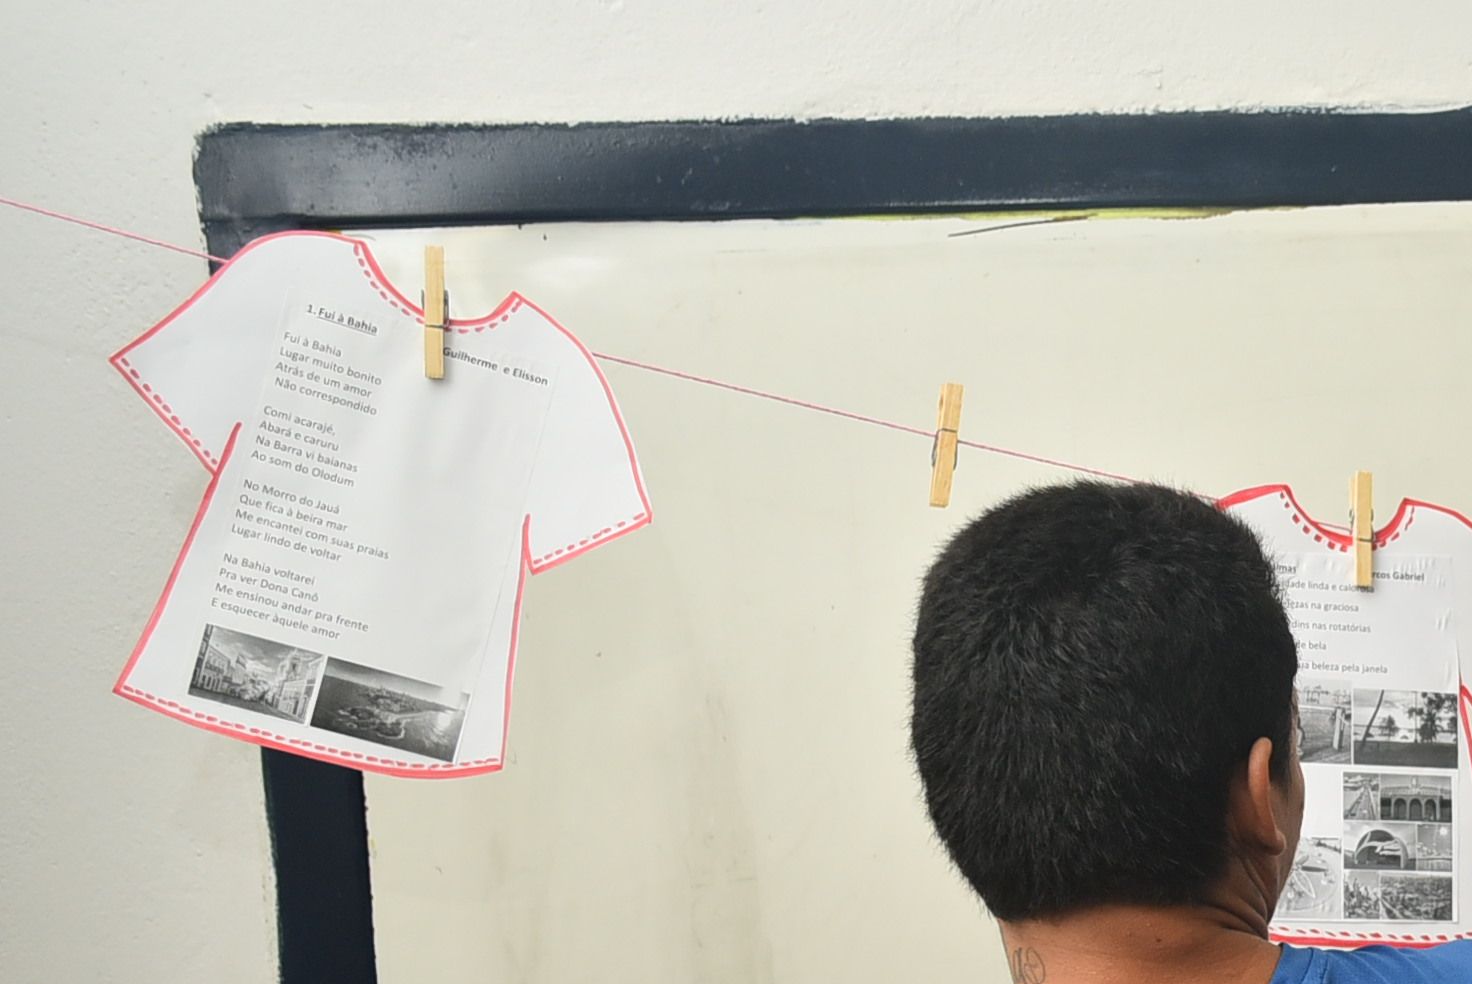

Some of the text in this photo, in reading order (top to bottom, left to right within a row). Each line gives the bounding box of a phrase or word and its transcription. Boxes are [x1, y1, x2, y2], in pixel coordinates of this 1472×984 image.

[306, 304, 378, 335] 1. Fui à Bahia
[284, 332, 341, 357] Fui à Bahia
[275, 362, 372, 398] Atrás de um amor
[280, 347, 382, 385] Lugar muito bonito
[442, 347, 548, 386] Guilherme e Elisson
[275, 377, 377, 415] Não correspondido
[259, 420, 292, 438] Abará
[304, 436, 339, 451] caruru
[264, 406, 335, 436] Comi acarajé,
[251, 450, 354, 487] Ao som do Olodum
[256, 435, 357, 472] Na Barra vi baianas
[240, 494, 348, 532] Que fica à beira mar
[244, 480, 340, 514] No Morro do Jauá
[232, 524, 341, 560] Lugar lindo de voltar
[236, 509, 389, 559] Me encantei com suas praias
[219, 568, 237, 580] Pra
[240, 575, 259, 586] ver
[260, 579, 288, 594] Dona
[224, 553, 315, 586] Na Bahia voltarei
[1308, 580, 1330, 590] linda
[1393, 570, 1425, 582] Gabriel
[212, 597, 218, 607] E
[221, 602, 271, 620] esquecer
[311, 626, 340, 639] amor
[216, 582, 368, 632] Me ensinou andar pra frente
[1282, 599, 1309, 609] elezas
[1324, 601, 1359, 612] graciosa
[1312, 622, 1327, 630] nas
[1329, 622, 1371, 633] rotatórias
[1309, 640, 1327, 650] bela
[1312, 661, 1339, 671] beleza
[1342, 661, 1360, 673] pela
[1362, 662, 1388, 674] janela
